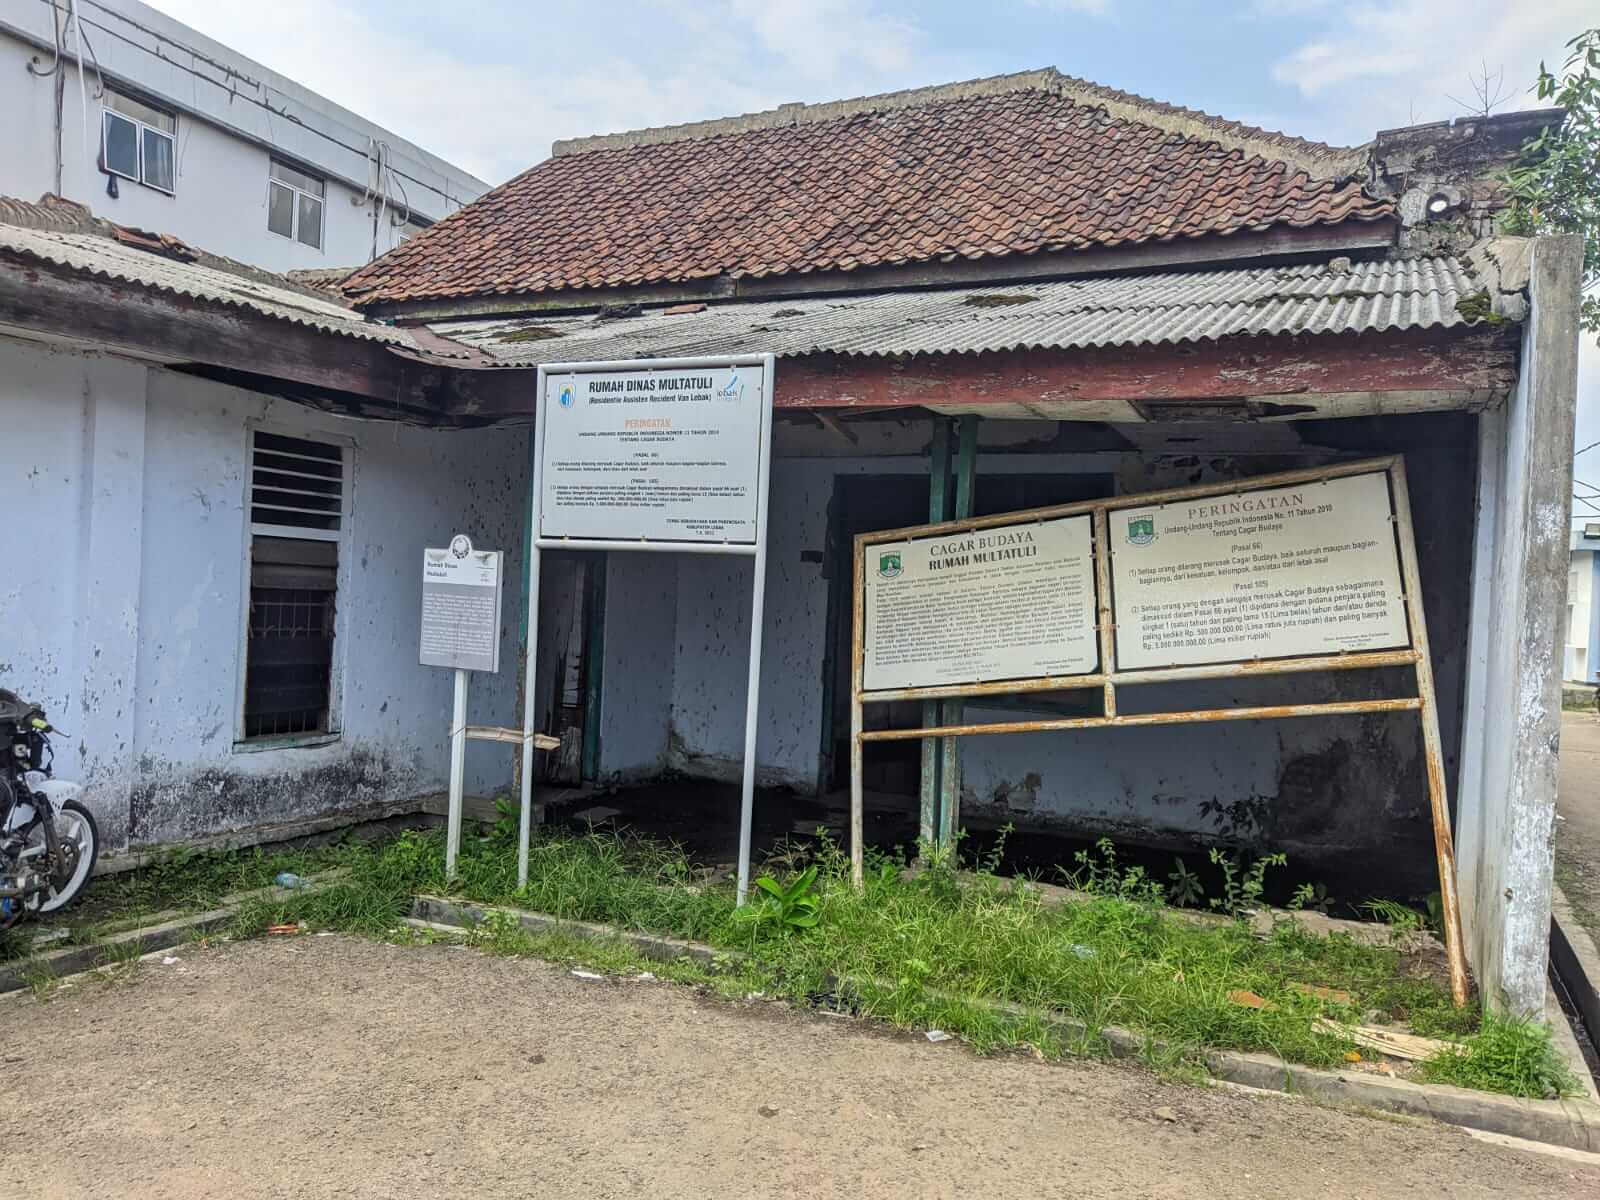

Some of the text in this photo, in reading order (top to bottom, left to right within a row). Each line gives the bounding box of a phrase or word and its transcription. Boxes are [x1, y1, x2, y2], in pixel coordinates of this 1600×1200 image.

[589, 376, 713, 393] RUMAH DINAS MULTATULI
[677, 394, 690, 402] Van
[690, 392, 712, 402] Lebak)
[624, 418, 672, 429] PERINGATAN
[1164, 520, 1213, 534] Undang-Undang
[1213, 517, 1240, 528] Republik
[1242, 513, 1274, 523] Indonesia
[1287, 510, 1295, 518] 11
[1296, 508, 1316, 517] Tahun
[1317, 503, 1334, 513] 2010
[1188, 493, 1304, 519] PERINGATAN
[1212, 523, 1283, 537] Tentang Cagar Budaya
[930, 531, 1034, 556] CAGAR BUDAYA
[1231, 544, 1251, 553] (Pasal
[929, 545, 1037, 570] RUMAH MULTATULI
[1128, 568, 1137, 577] (1)
[1231, 556, 1251, 566] Cagar
[1322, 543, 1351, 553] maupun
[1351, 540, 1378, 550] bagian-
[1173, 573, 1186, 581] dari
[1282, 560, 1296, 569] dari
[1199, 598, 1225, 607] dengan
[1253, 591, 1282, 600] merusak
[1284, 589, 1306, 598] Cagar
[1306, 584, 1334, 595] Budaya
[1335, 580, 1384, 592] sebagaimana
[1232, 581, 1252, 592] (Pasal
[1189, 618, 1208, 627] tahun
[1208, 617, 1222, 625] dan
[1222, 615, 1243, 625] paling
[1312, 605, 1332, 614] tahun
[1365, 599, 1387, 608] denda
[1194, 608, 1213, 616] Pasal
[1238, 604, 1248, 613] (1)
[1280, 598, 1307, 608] dengan
[1308, 595, 1333, 604] pidana
[1333, 593, 1361, 603] penjara
[1362, 589, 1386, 600] paling
[1142, 633, 1162, 642] paling
[1323, 614, 1337, 623] dan
[1338, 612, 1361, 622] paling
[1361, 609, 1388, 620] banyak
